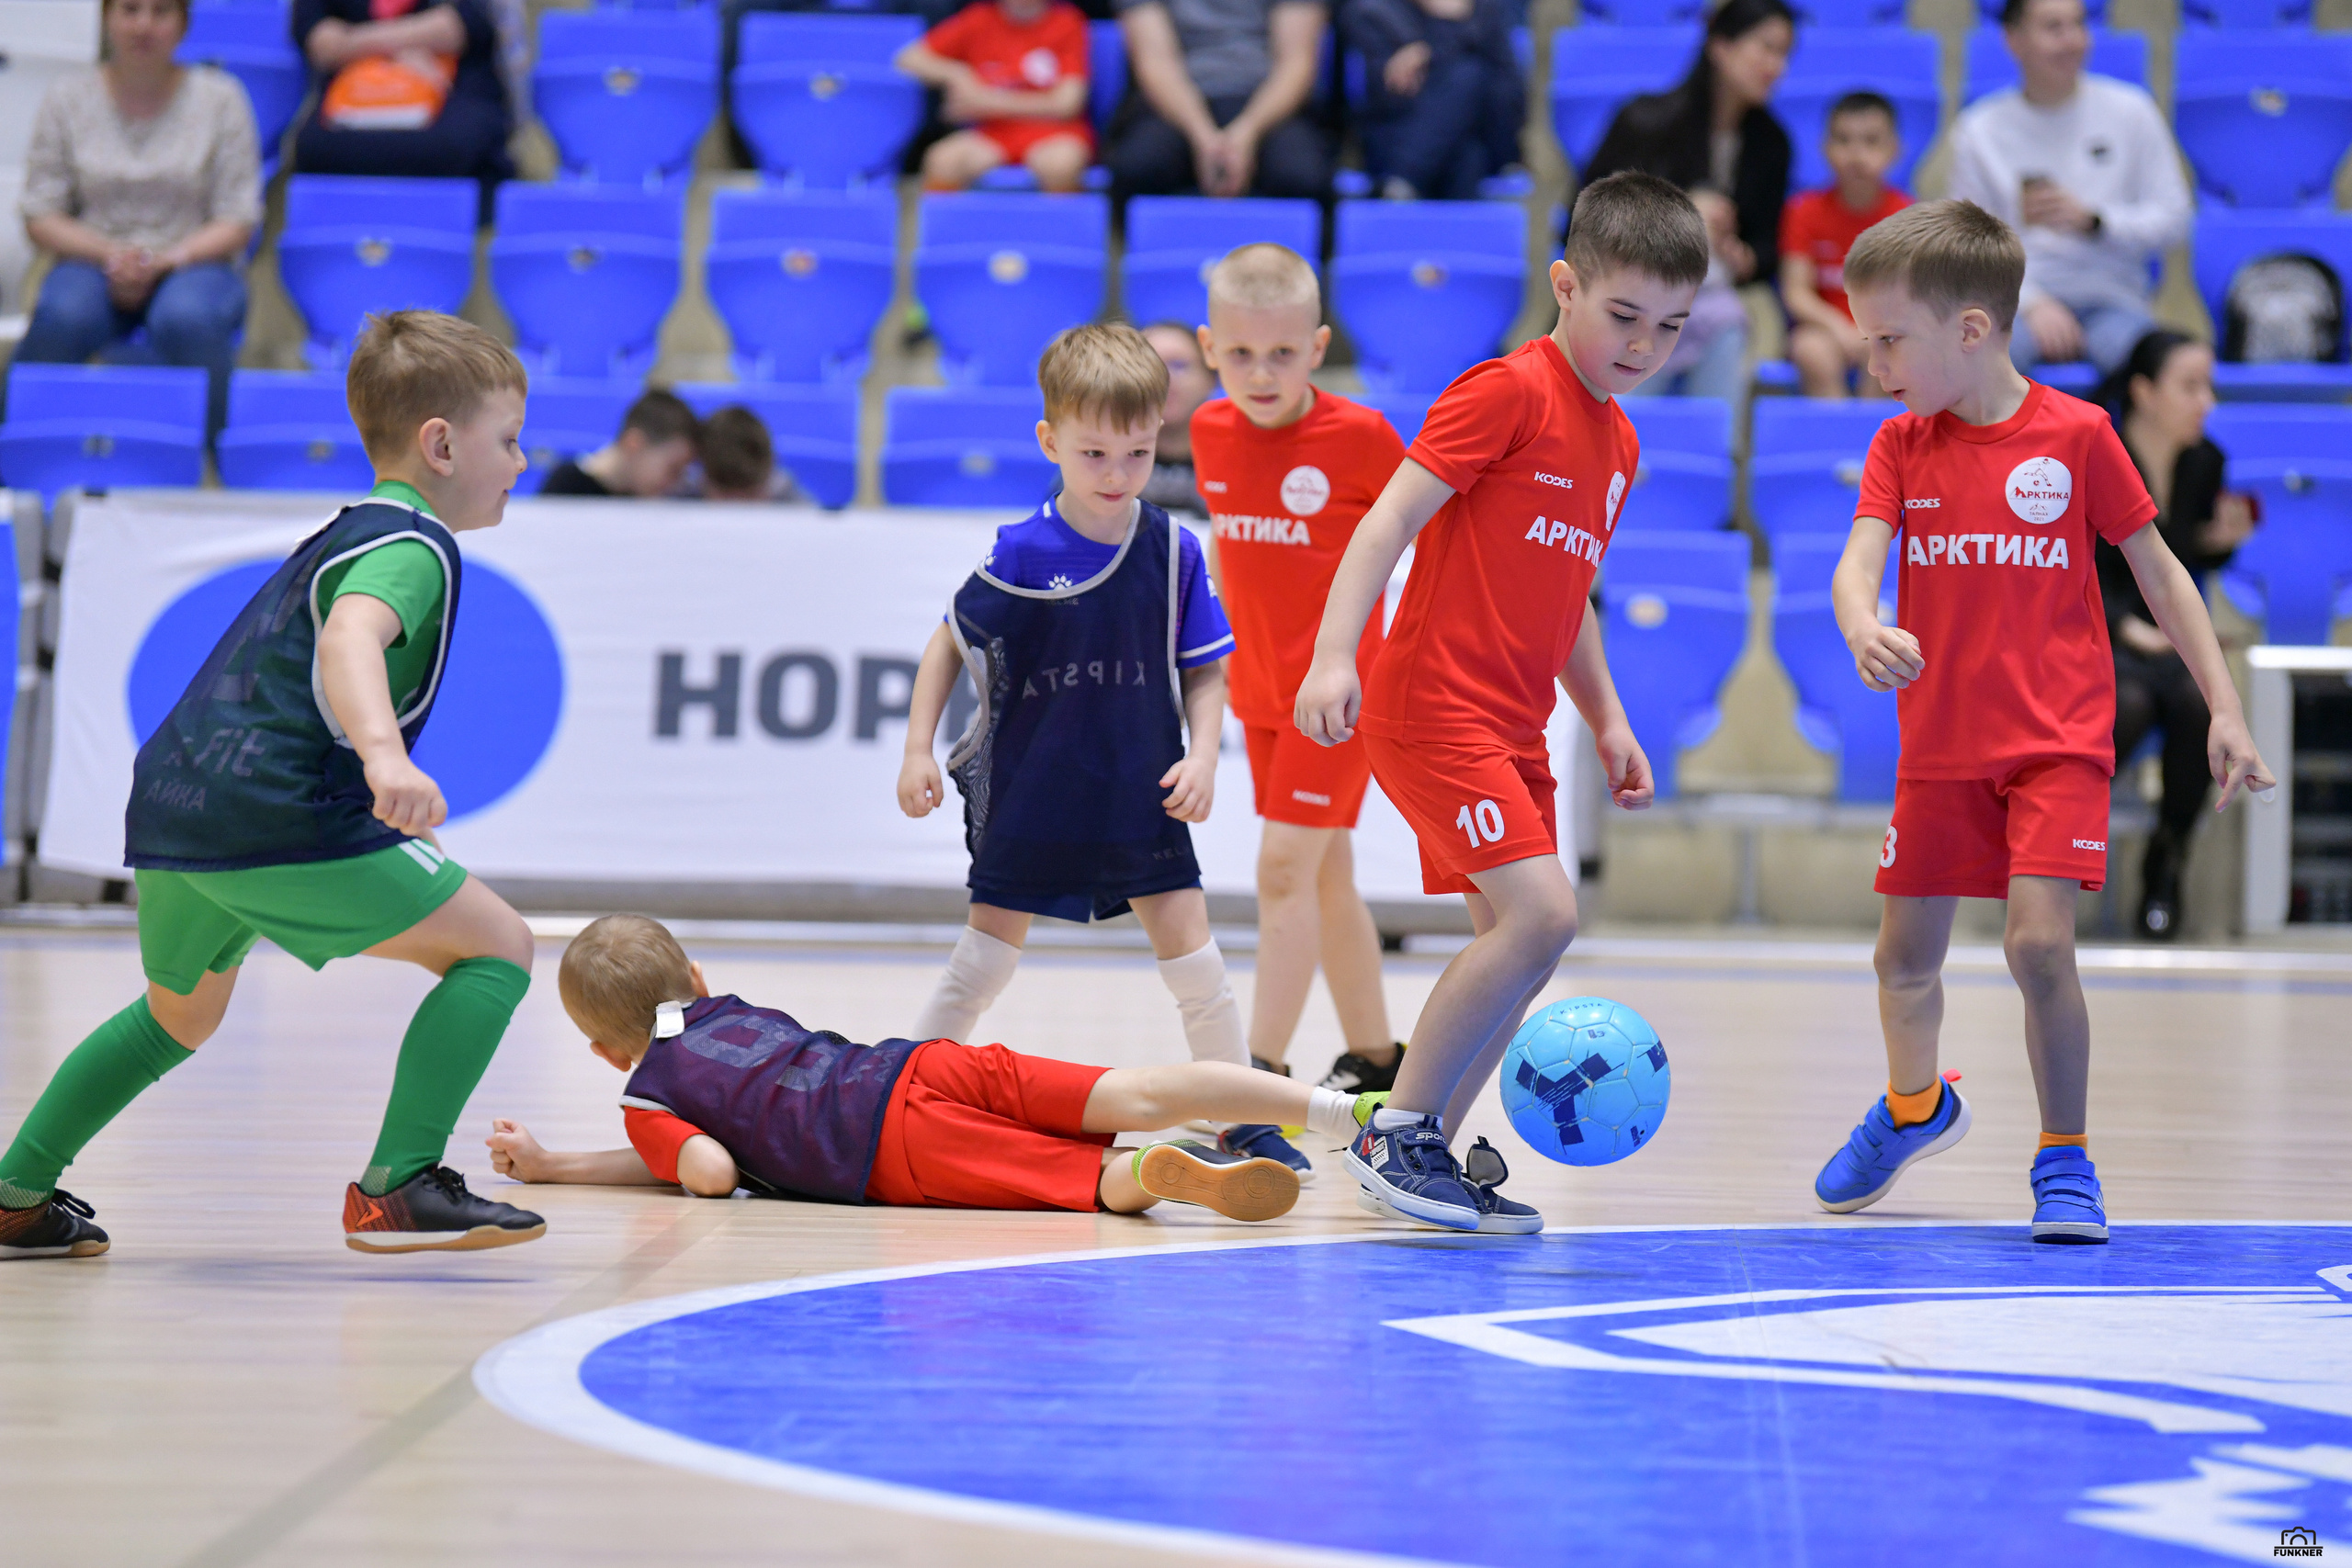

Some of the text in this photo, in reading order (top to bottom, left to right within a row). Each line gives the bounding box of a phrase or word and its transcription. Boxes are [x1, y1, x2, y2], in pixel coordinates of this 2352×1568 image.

[1534, 471, 1574, 490] KODES
[1905, 498, 1941, 509] KODES
[1212, 512, 1311, 547] РКТИКА
[1907, 534, 2069, 570] АРКТИКА
[1455, 799, 1505, 848] 10
[2073, 839, 2106, 851] KODES
[1559, 1002, 1603, 1015] KIPSTA
